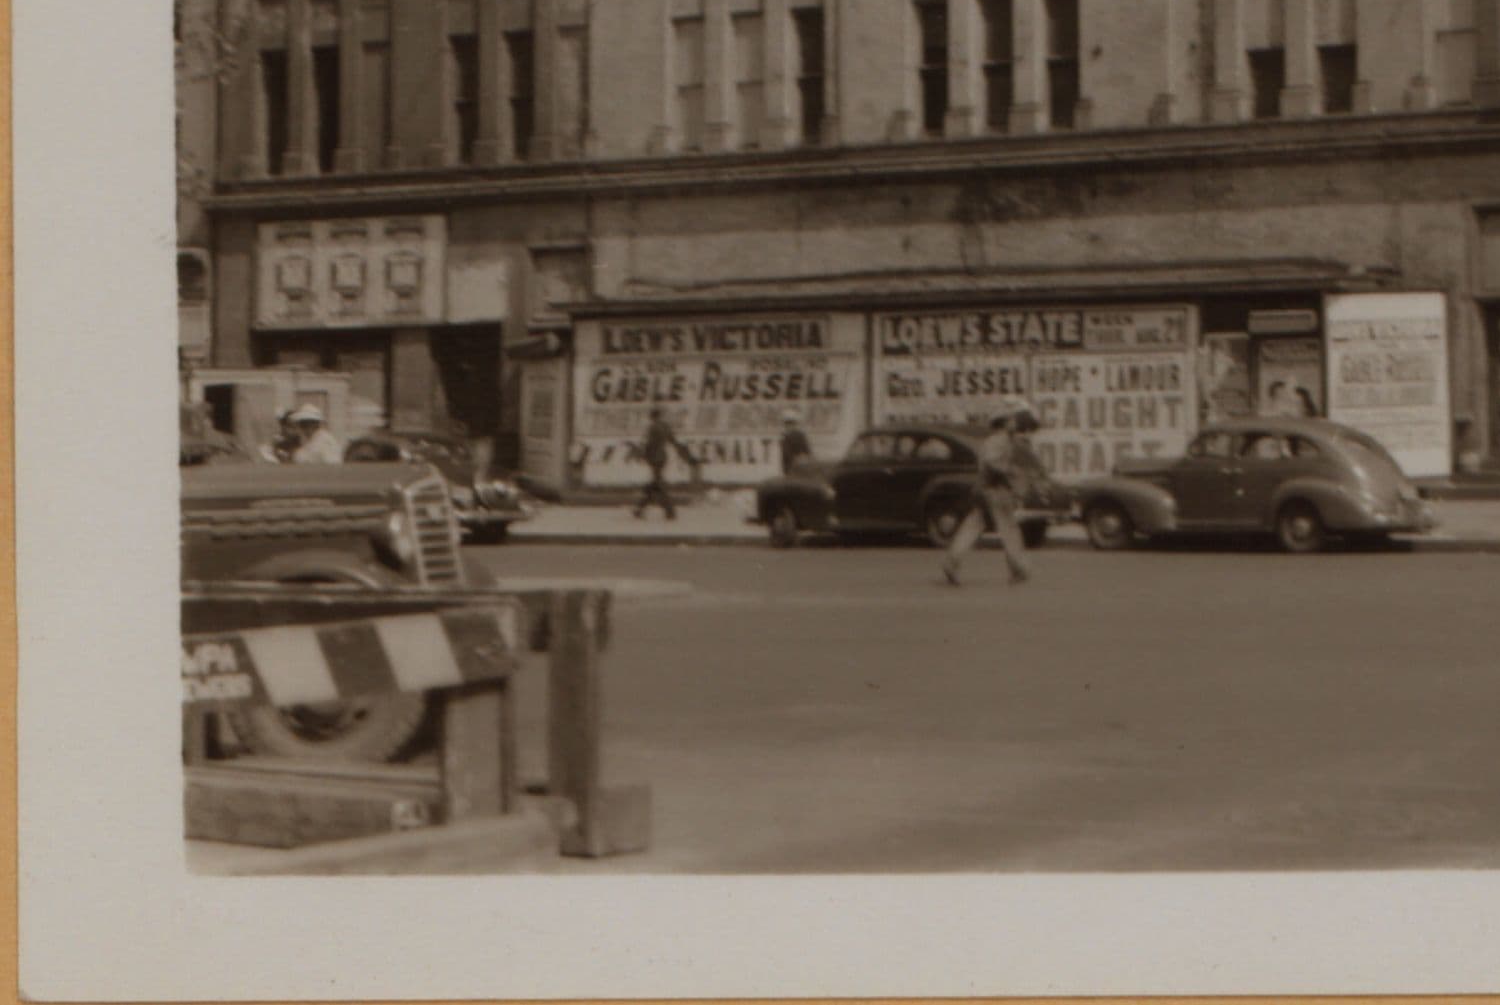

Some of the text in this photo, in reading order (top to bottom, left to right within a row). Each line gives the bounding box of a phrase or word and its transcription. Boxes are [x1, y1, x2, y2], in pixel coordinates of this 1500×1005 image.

[691, 322, 824, 352] VICTORIA
[987, 310, 1081, 344] STATE
[591, 368, 686, 403] GABLE
[699, 360, 839, 401] RUSSELL
[935, 367, 1025, 396] JESSEL
[1039, 396, 1183, 429] CAUGHT
